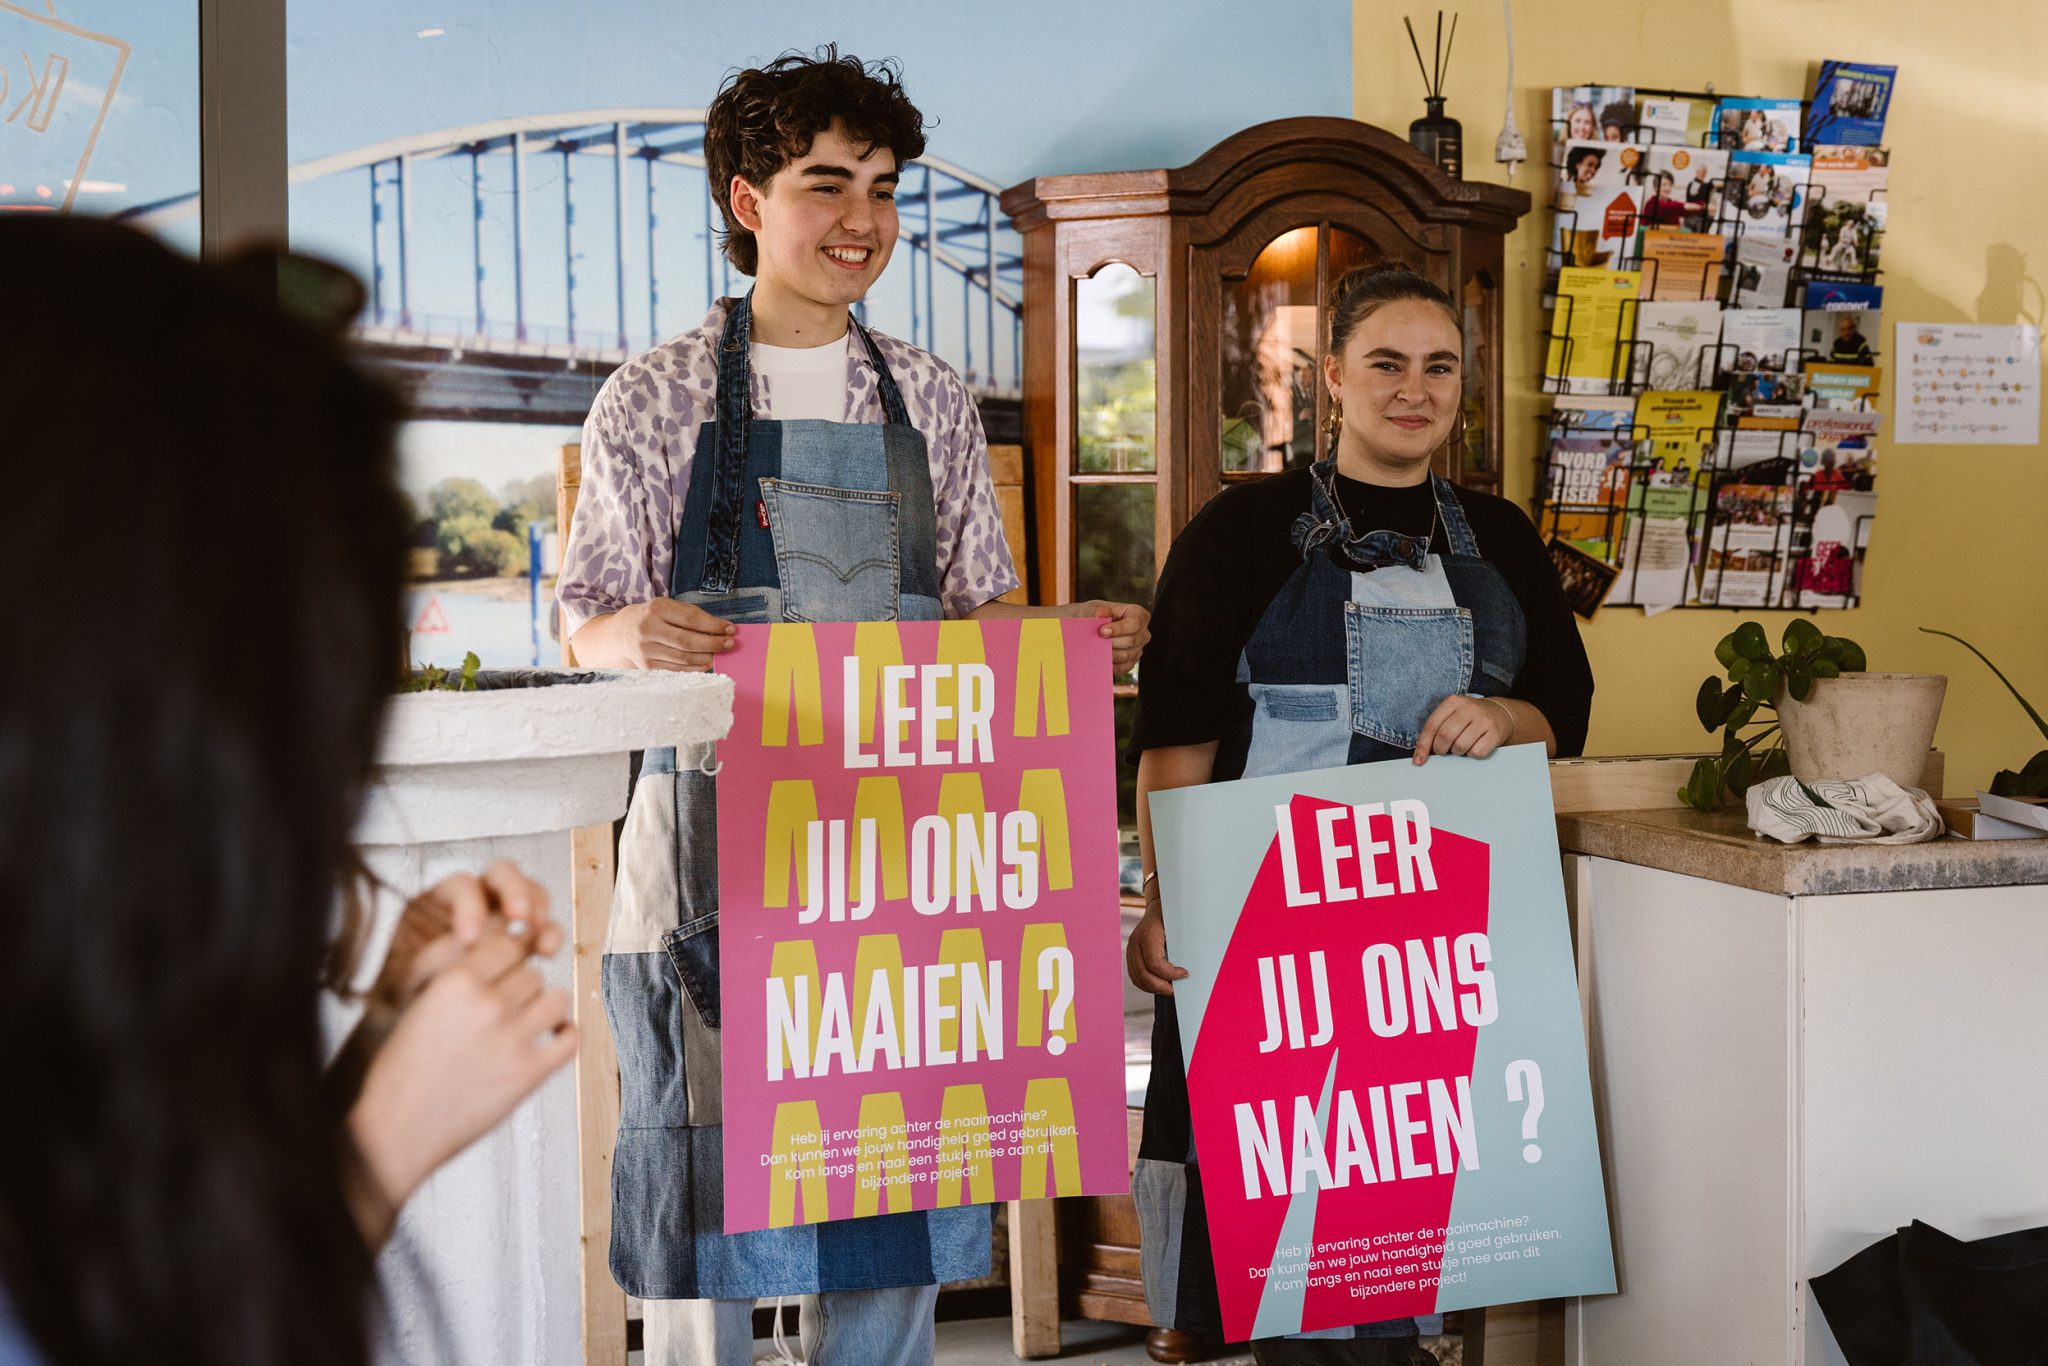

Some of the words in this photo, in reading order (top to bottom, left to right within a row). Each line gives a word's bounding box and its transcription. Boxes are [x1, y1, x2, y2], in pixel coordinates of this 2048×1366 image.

[1557, 452, 1607, 469] WORD
[843, 655, 995, 769] LEER
[798, 818, 877, 925] JIJ
[911, 810, 1039, 916] ONS
[1275, 799, 1438, 908] LEER
[765, 959, 1004, 1082] NAAIEN
[1037, 946, 1075, 1056] ?
[1257, 950, 1334, 1053] JIJ
[1361, 932, 1499, 1038] ONS
[760, 1154, 787, 1166] Dan
[791, 1148, 839, 1162] kunnen
[843, 1146, 861, 1157] we
[864, 1142, 894, 1158] jouw
[898, 1133, 969, 1150] handigheid
[973, 1129, 1006, 1145] goed
[1010, 1125, 1079, 1143] gebruiken.
[791, 1133, 817, 1145] Heb
[820, 1130, 830, 1145] jij
[833, 1125, 887, 1141] ervaring
[890, 1121, 931, 1135] achter
[935, 1118, 951, 1130] de
[954, 1109, 1047, 1128] naaimachine?
[1233, 1075, 1480, 1200] NAAIEN
[1504, 1058, 1545, 1164] ?
[785, 1168, 815, 1180] Kom
[818, 1163, 854, 1178] langs
[858, 1161, 873, 1172] en
[877, 1156, 905, 1169] naai
[909, 1156, 931, 1166] een
[935, 1150, 972, 1163] stukje
[976, 1147, 1005, 1159] mee
[1008, 1144, 1034, 1155] aan
[1038, 1141, 1055, 1153] dit
[862, 1171, 927, 1190] bijzondere
[930, 1165, 978, 1184] project!
[1249, 1267, 1274, 1279] Dan
[1278, 1260, 1325, 1275] kunnen
[1328, 1257, 1346, 1268] we
[1349, 1253, 1379, 1268] jouw
[1382, 1241, 1454, 1260] handigheid
[1458, 1236, 1491, 1253] goed
[1494, 1230, 1562, 1247] gebruiken.
[1276, 1247, 1302, 1259] Heb
[1304, 1243, 1314, 1258] jij
[1317, 1237, 1370, 1253] ervaring
[1373, 1230, 1414, 1245] achter
[1417, 1228, 1434, 1239] de
[1437, 1215, 1529, 1237] naaimachine?
[1274, 1279, 1303, 1292] Kom
[1306, 1273, 1341, 1287] langs
[1345, 1271, 1360, 1282] en
[1364, 1265, 1392, 1279] naai
[1395, 1263, 1418, 1274] een
[1422, 1258, 1459, 1271] stukje
[1462, 1254, 1491, 1265] mee
[1494, 1250, 1520, 1261] aan
[1523, 1246, 1540, 1257] dit
[1350, 1280, 1416, 1299] bijzondere
[1419, 1272, 1467, 1291] project!
